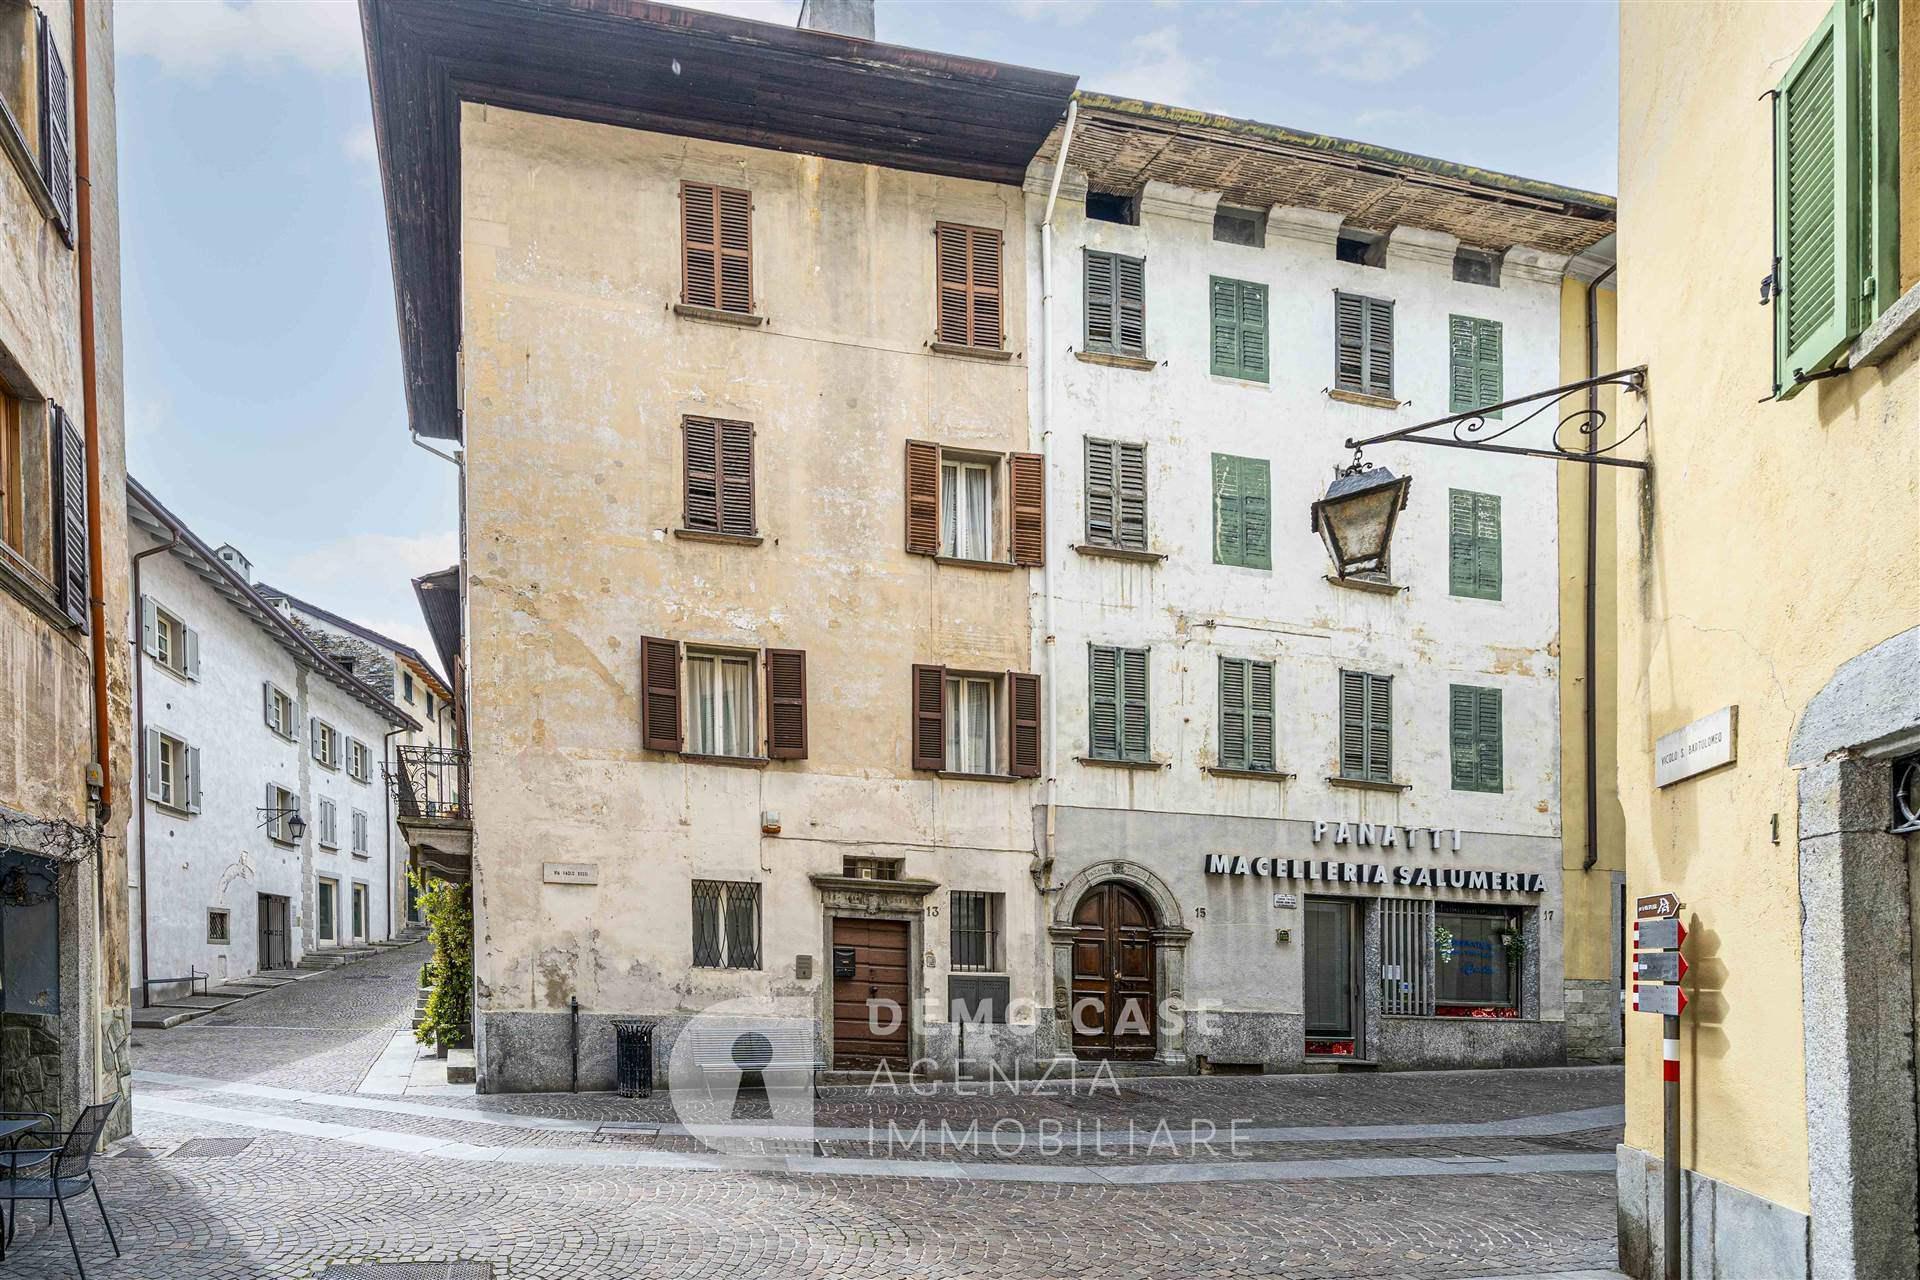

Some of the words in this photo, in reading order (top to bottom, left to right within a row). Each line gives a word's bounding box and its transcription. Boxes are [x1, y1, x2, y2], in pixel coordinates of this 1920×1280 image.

[1312, 820, 1462, 852] PANATTI
[1205, 854, 1389, 884] MACELLERIA
[1393, 865, 1549, 892] SALUMERIA
[926, 905, 940, 918] 13
[1194, 907, 1207, 919] 15
[1543, 909, 1555, 921] 17
